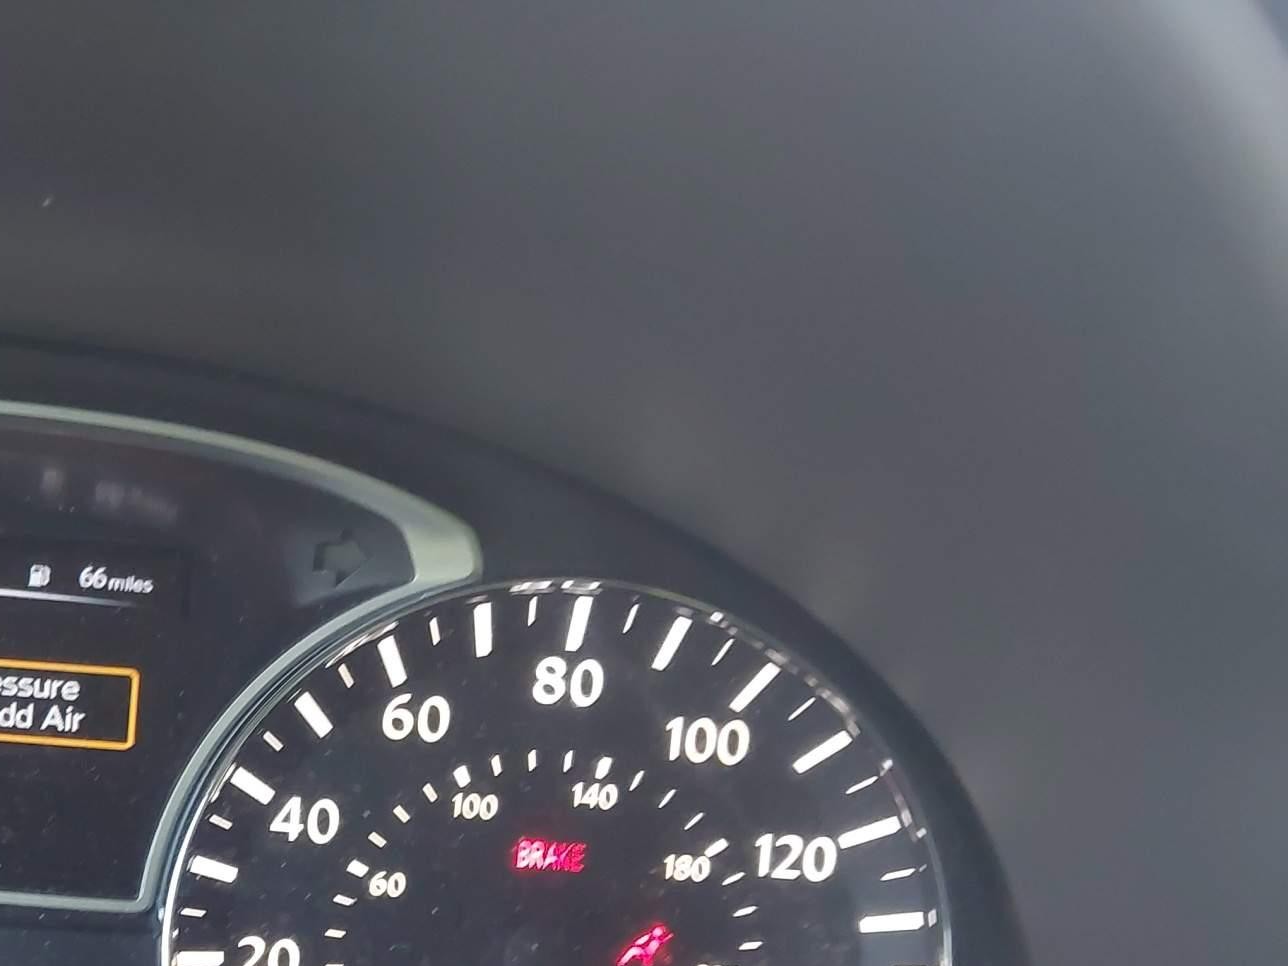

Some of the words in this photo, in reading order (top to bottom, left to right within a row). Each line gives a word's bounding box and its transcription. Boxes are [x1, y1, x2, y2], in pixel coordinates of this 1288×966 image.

[79, 566, 107, 588] 66
[108, 575, 154, 593] miles
[532, 656, 604, 707] 80
[40, 706, 86, 733] Air
[381, 693, 451, 743] 60
[664, 715, 751, 766] 100
[451, 792, 499, 821] 100
[571, 781, 619, 811] 140
[269, 796, 340, 845] 40
[514, 837, 586, 871] BRAKE
[663, 853, 711, 883] 180
[754, 832, 839, 882] 120
[368, 871, 407, 898] 60
